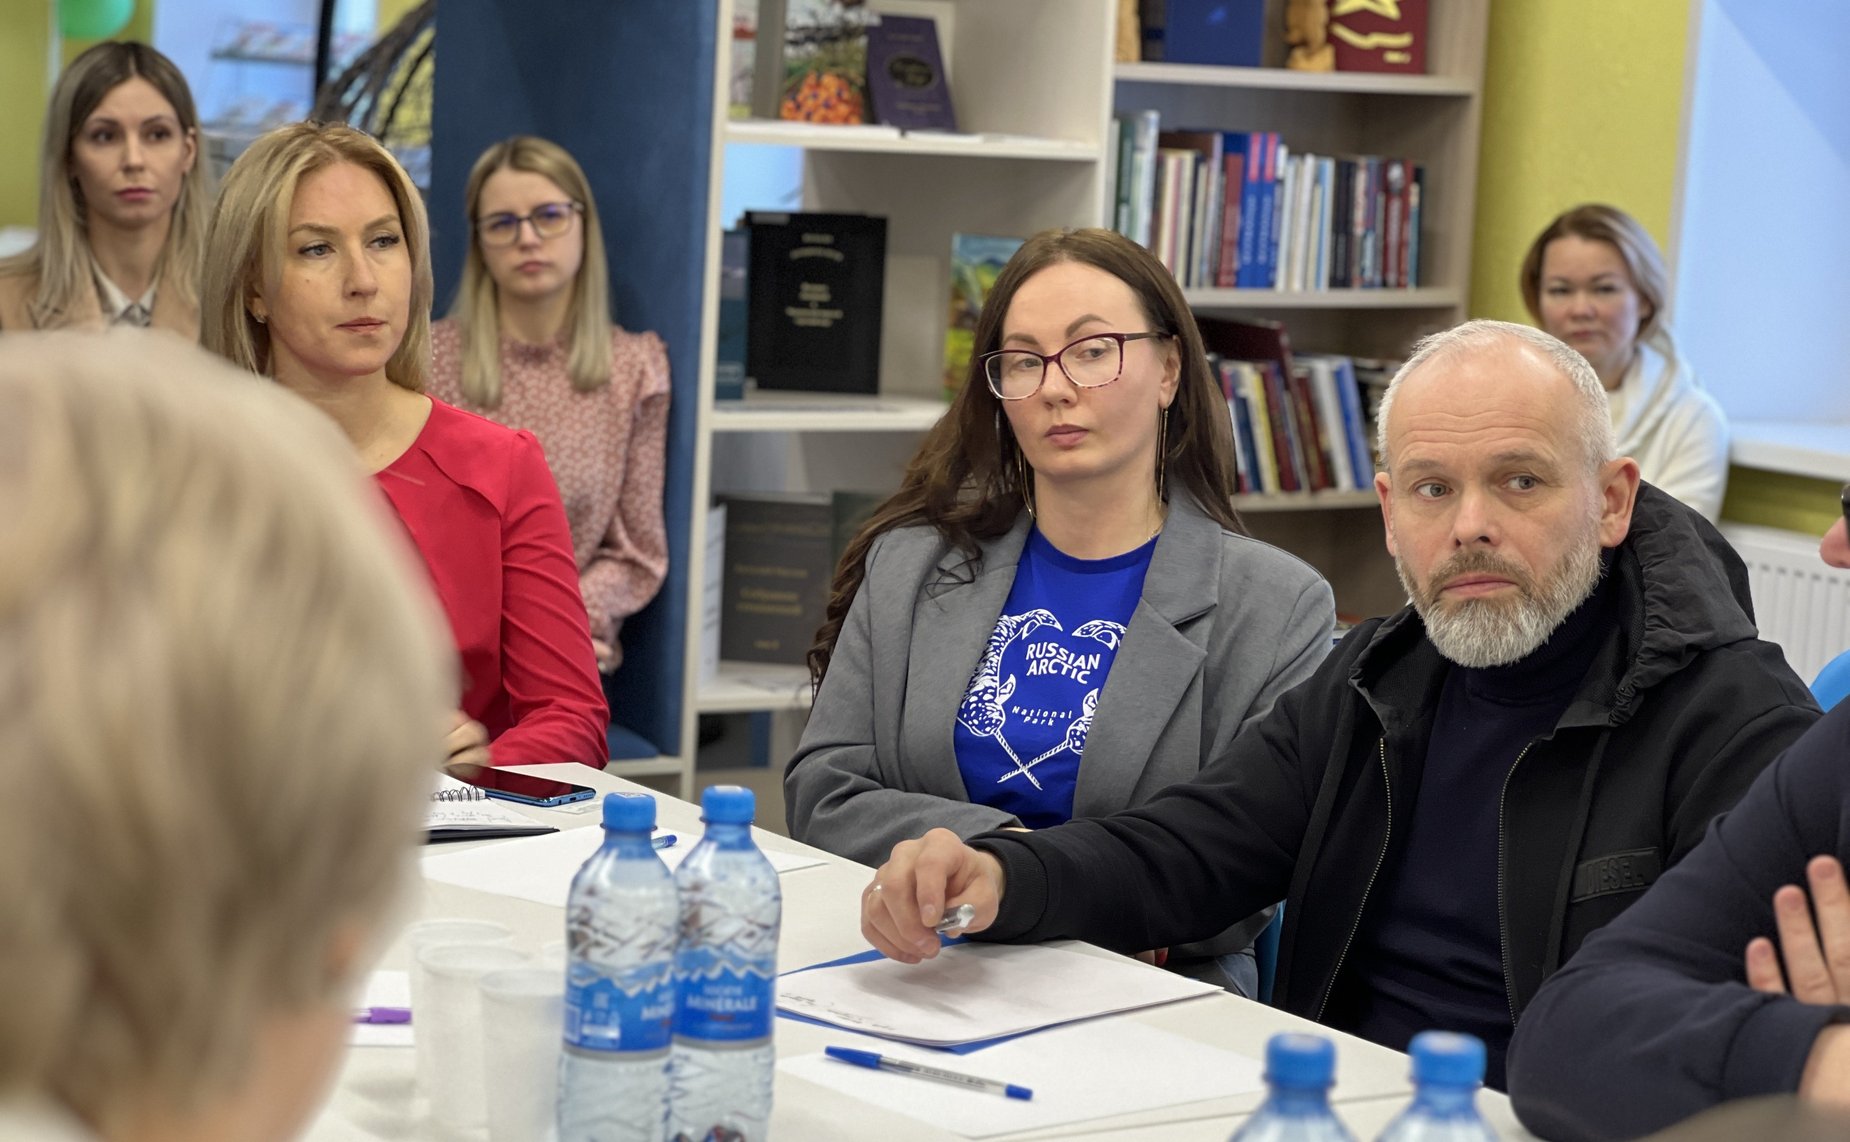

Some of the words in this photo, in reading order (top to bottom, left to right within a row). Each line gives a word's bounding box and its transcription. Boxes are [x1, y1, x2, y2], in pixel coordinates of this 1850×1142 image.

[1026, 642, 1100, 670] RUSSIAN
[1026, 658, 1090, 684] ARCTIC
[1012, 706, 1072, 719] National
[1024, 716, 1054, 726] Park
